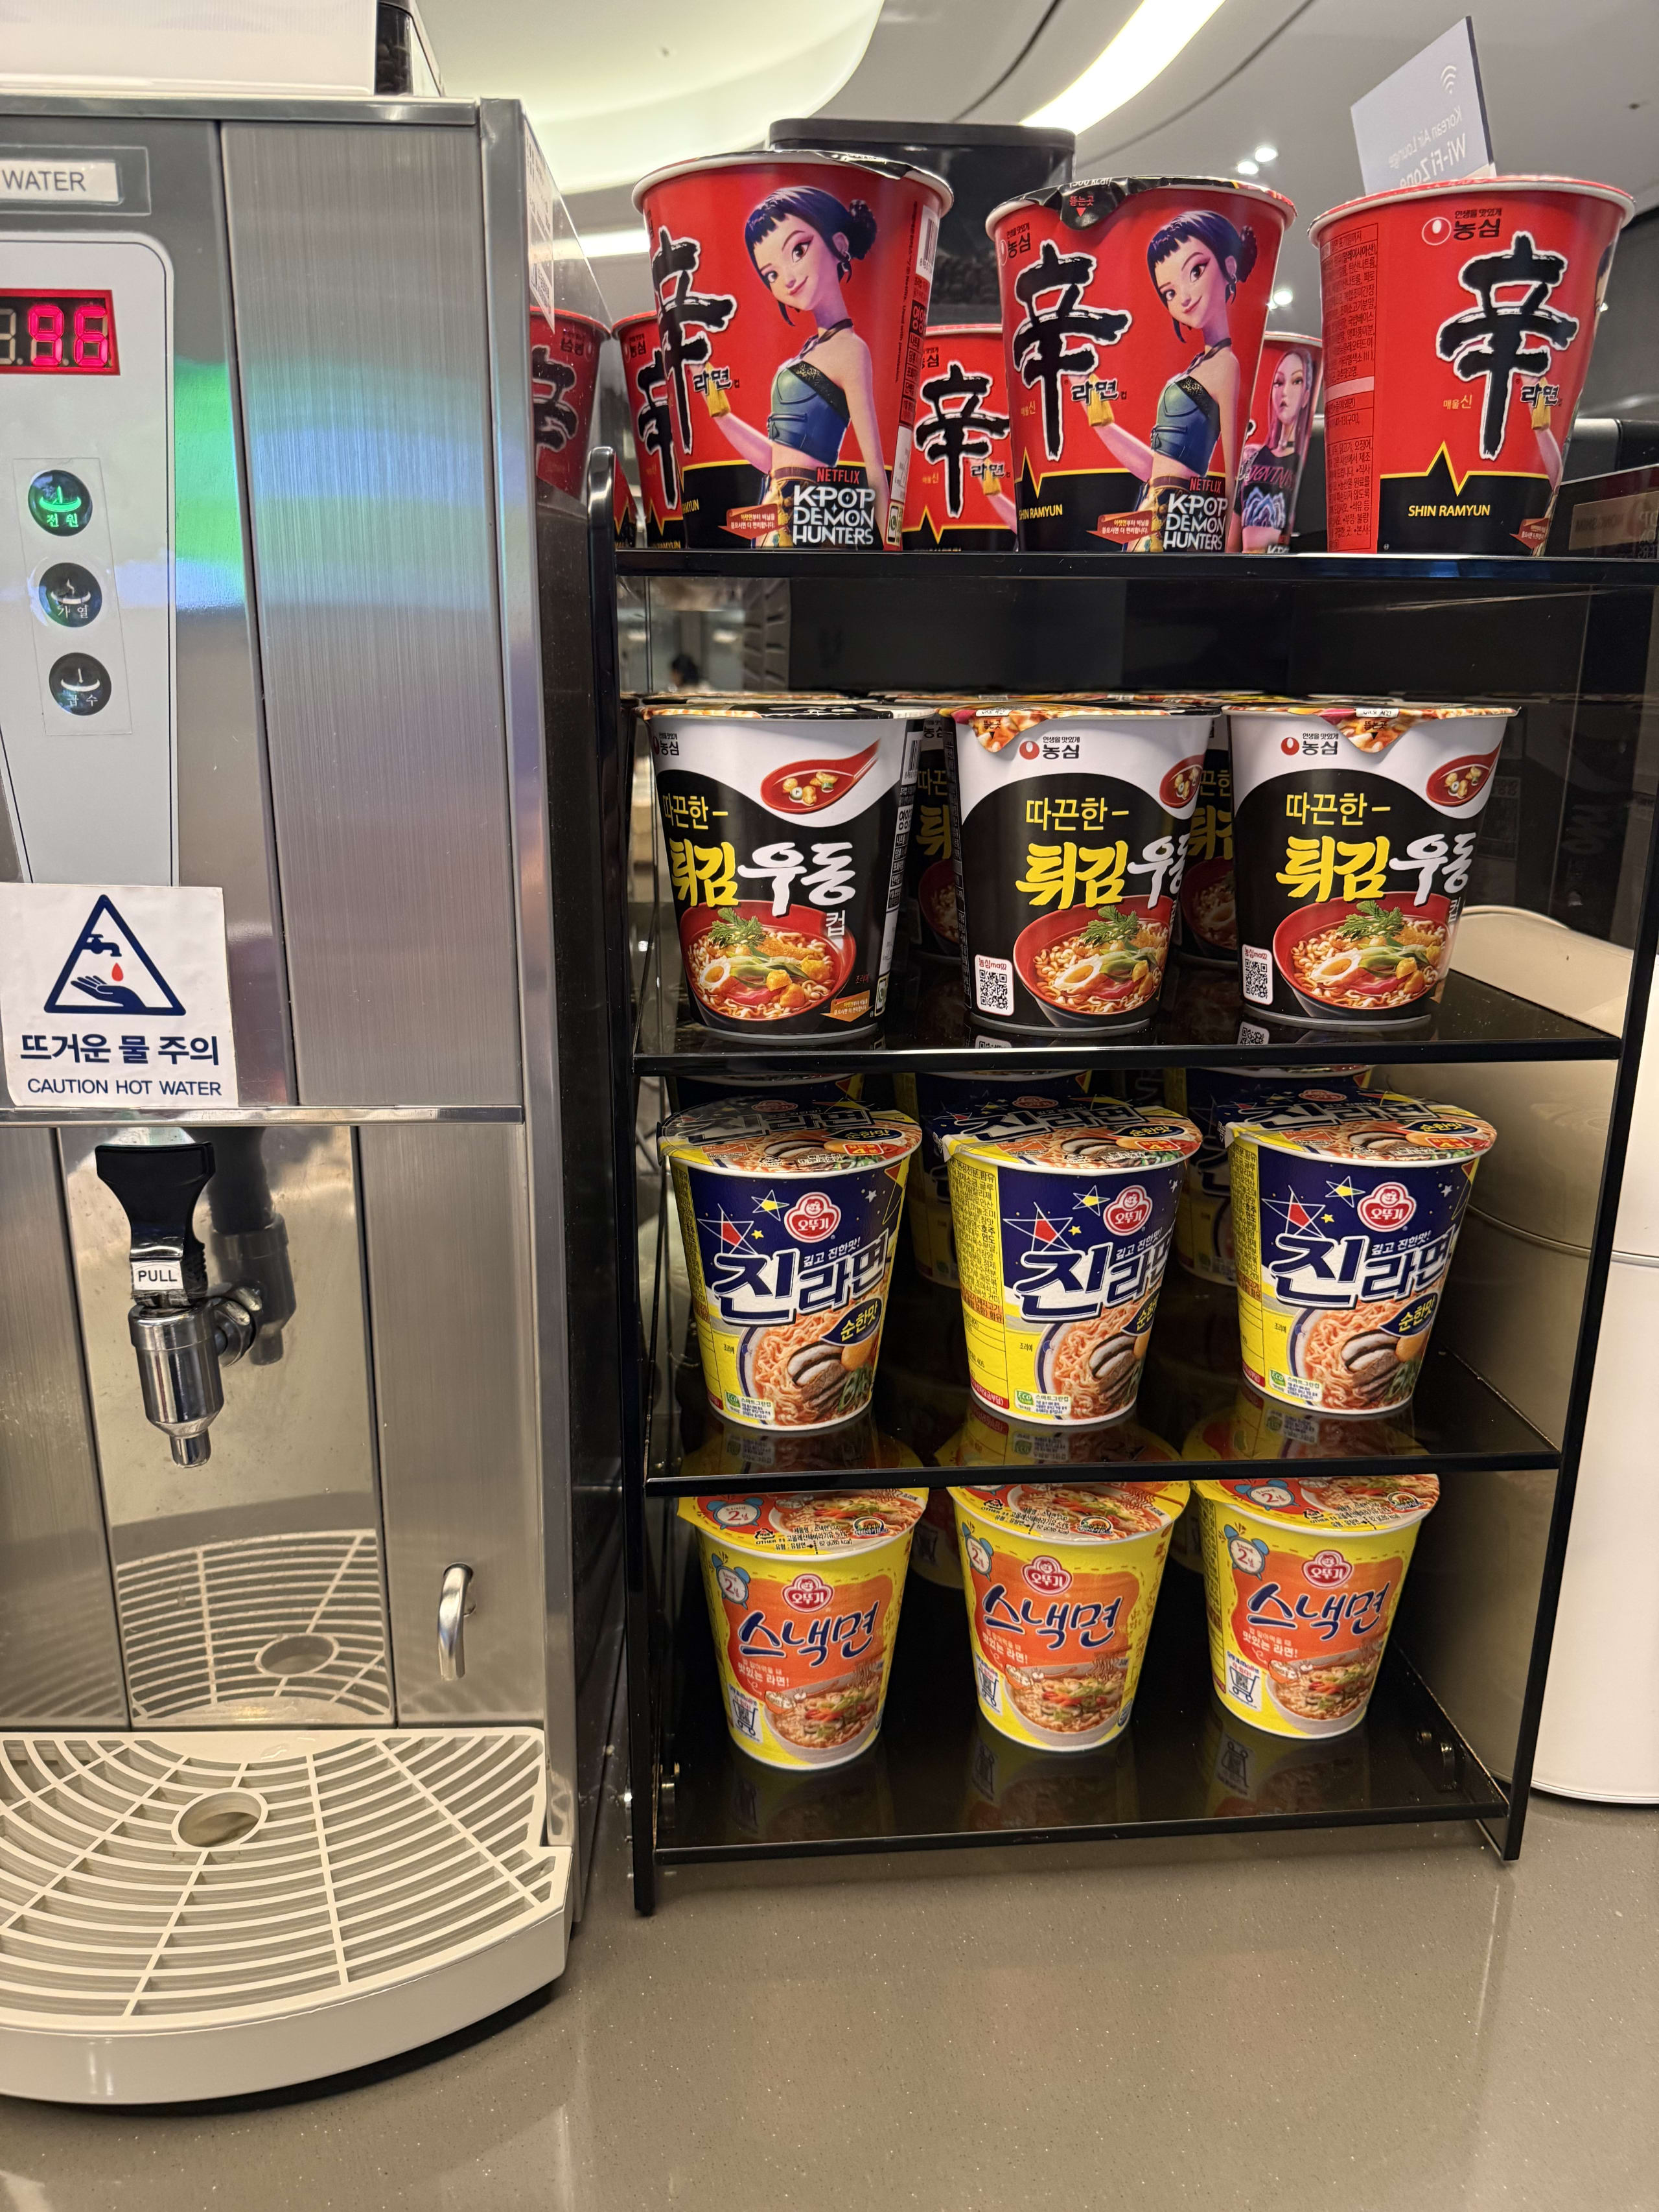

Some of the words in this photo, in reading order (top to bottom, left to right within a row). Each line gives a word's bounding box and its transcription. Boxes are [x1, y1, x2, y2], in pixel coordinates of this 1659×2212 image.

[2, 170, 86, 192] WATER
[1453, 218, 1501, 241] 농심
[1007, 232, 1030, 259] 농심
[28, 305, 109, 367] 96
[1436, 231, 1579, 461] 辛
[1013, 239, 1132, 462] 辛
[693, 366, 732, 395] 라면
[1070, 378, 1119, 405] 라면
[1520, 384, 1559, 407] 라면
[914, 361, 1010, 518] 辛
[817, 467, 860, 485] NETFLIX
[971, 463, 1005, 480] 라면
[1189, 477, 1222, 494] NETFLIX
[793, 506, 875, 531] DEMON
[1030, 504, 1063, 519] RAMYUN
[1408, 505, 1436, 517] SHIN
[1439, 504, 1491, 517] RAMYUN
[1166, 513, 1226, 535] DEMON
[793, 525, 874, 546] HUNTERS
[1163, 530, 1223, 551] HUNTERS
[660, 739, 680, 756] 농심
[1042, 744, 1080, 760] 농심
[1302, 740, 1338, 756] 농심
[824, 909, 846, 937] 컵
[20, 1033, 111, 1064] 뜨거운
[119, 1034, 150, 1065] 물
[157, 1035, 219, 1066] 주의
[27, 1078, 108, 1095] CAUTION
[116, 1080, 152, 1095] HOT
[159, 1080, 222, 1096] WATER
[845, 1128, 890, 1139] 순한맛
[1129, 1124, 1171, 1137] 순한맛
[797, 1216, 830, 1231] 오뚜기
[1114, 1208, 1143, 1226] 오뚜기
[1371, 1207, 1404, 1222] 오뚜기
[804, 1253, 826, 1268] 깊고
[828, 1236, 861, 1262] 진한맛!
[1115, 1245, 1135, 1261] 깊고
[1371, 1242, 1395, 1257] 깊고
[1397, 1230, 1432, 1252] 진한맛!
[137, 1270, 178, 1283] PULL
[711, 1228, 891, 1327] 진라면
[1270, 1223, 1457, 1310] 진라면
[841, 1303, 879, 1342] 순한맛
[1398, 1296, 1436, 1333] 순한맛
[1030, 1572, 1064, 1589] 오뚜기
[1310, 1567, 1344, 1581] 오뚜기
[791, 1591, 825, 1605] 오뚜기
[982, 1583, 1124, 1651] 스낵면
[1247, 1583, 1390, 1641] 스낵면
[738, 1600, 880, 1668] 스낵면
[1242, 1631, 1271, 1651] 맛있는
[1273, 1643, 1298, 1659] 라면!
[1006, 1647, 1028, 1664] 라면!
[737, 1662, 763, 1682] 맛있는
[766, 1674, 790, 1688] 라면!
